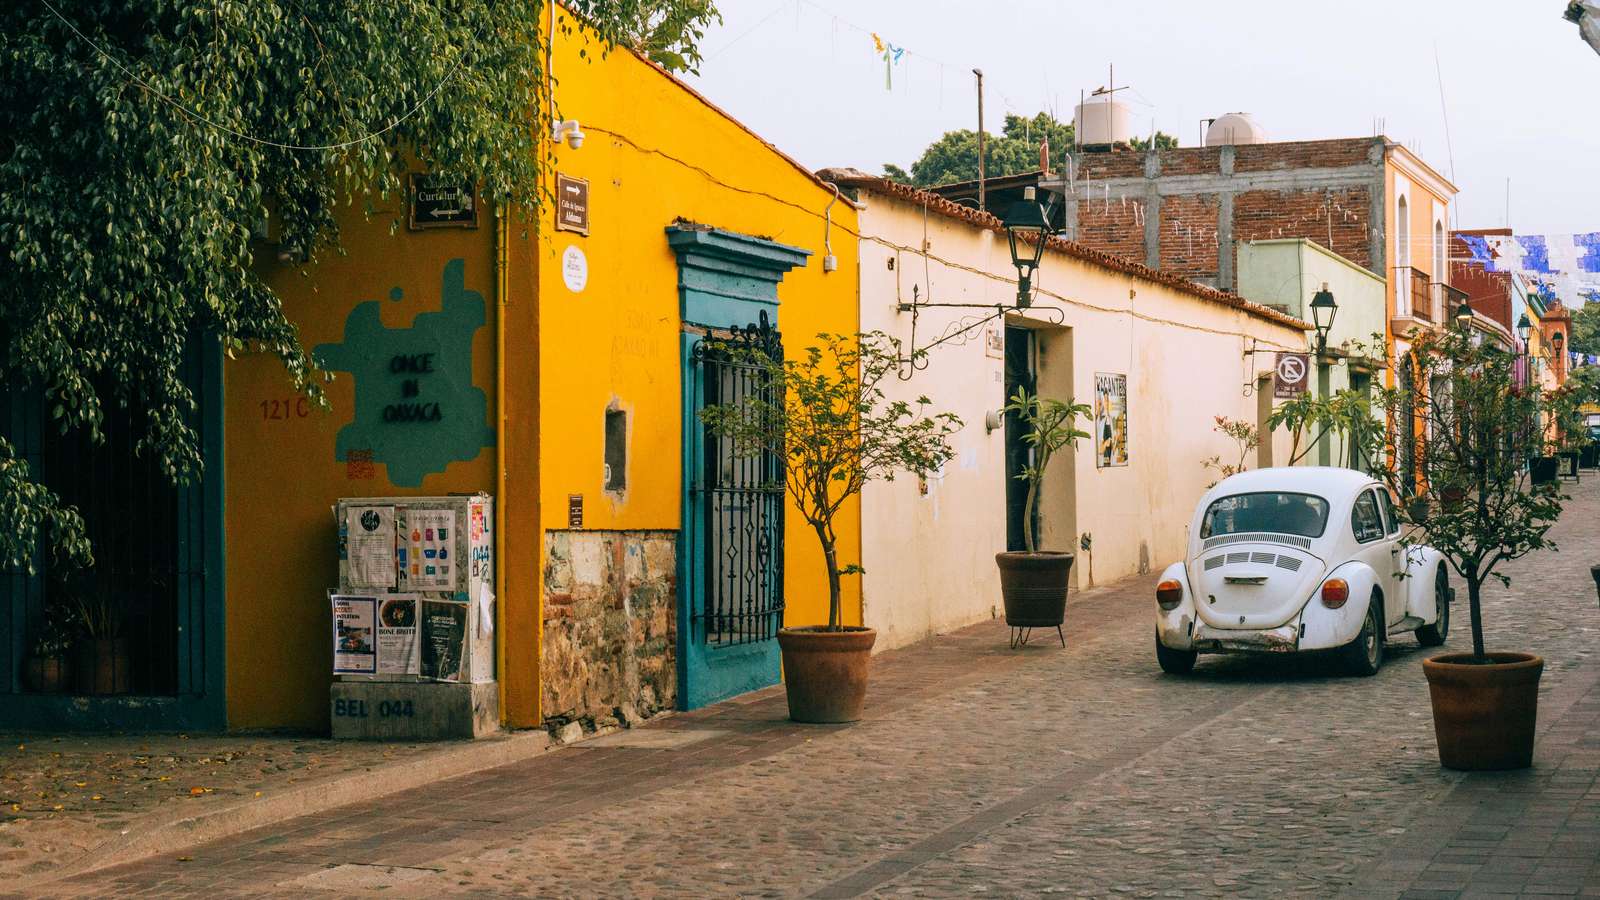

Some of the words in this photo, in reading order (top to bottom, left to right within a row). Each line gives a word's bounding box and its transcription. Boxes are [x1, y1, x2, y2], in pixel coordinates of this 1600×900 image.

[389, 353, 435, 373] ONCE
[402, 379, 419, 398] IN
[384, 402, 442, 423] OAXACA
[335, 699, 368, 717] BEL
[379, 700, 414, 718] 044
